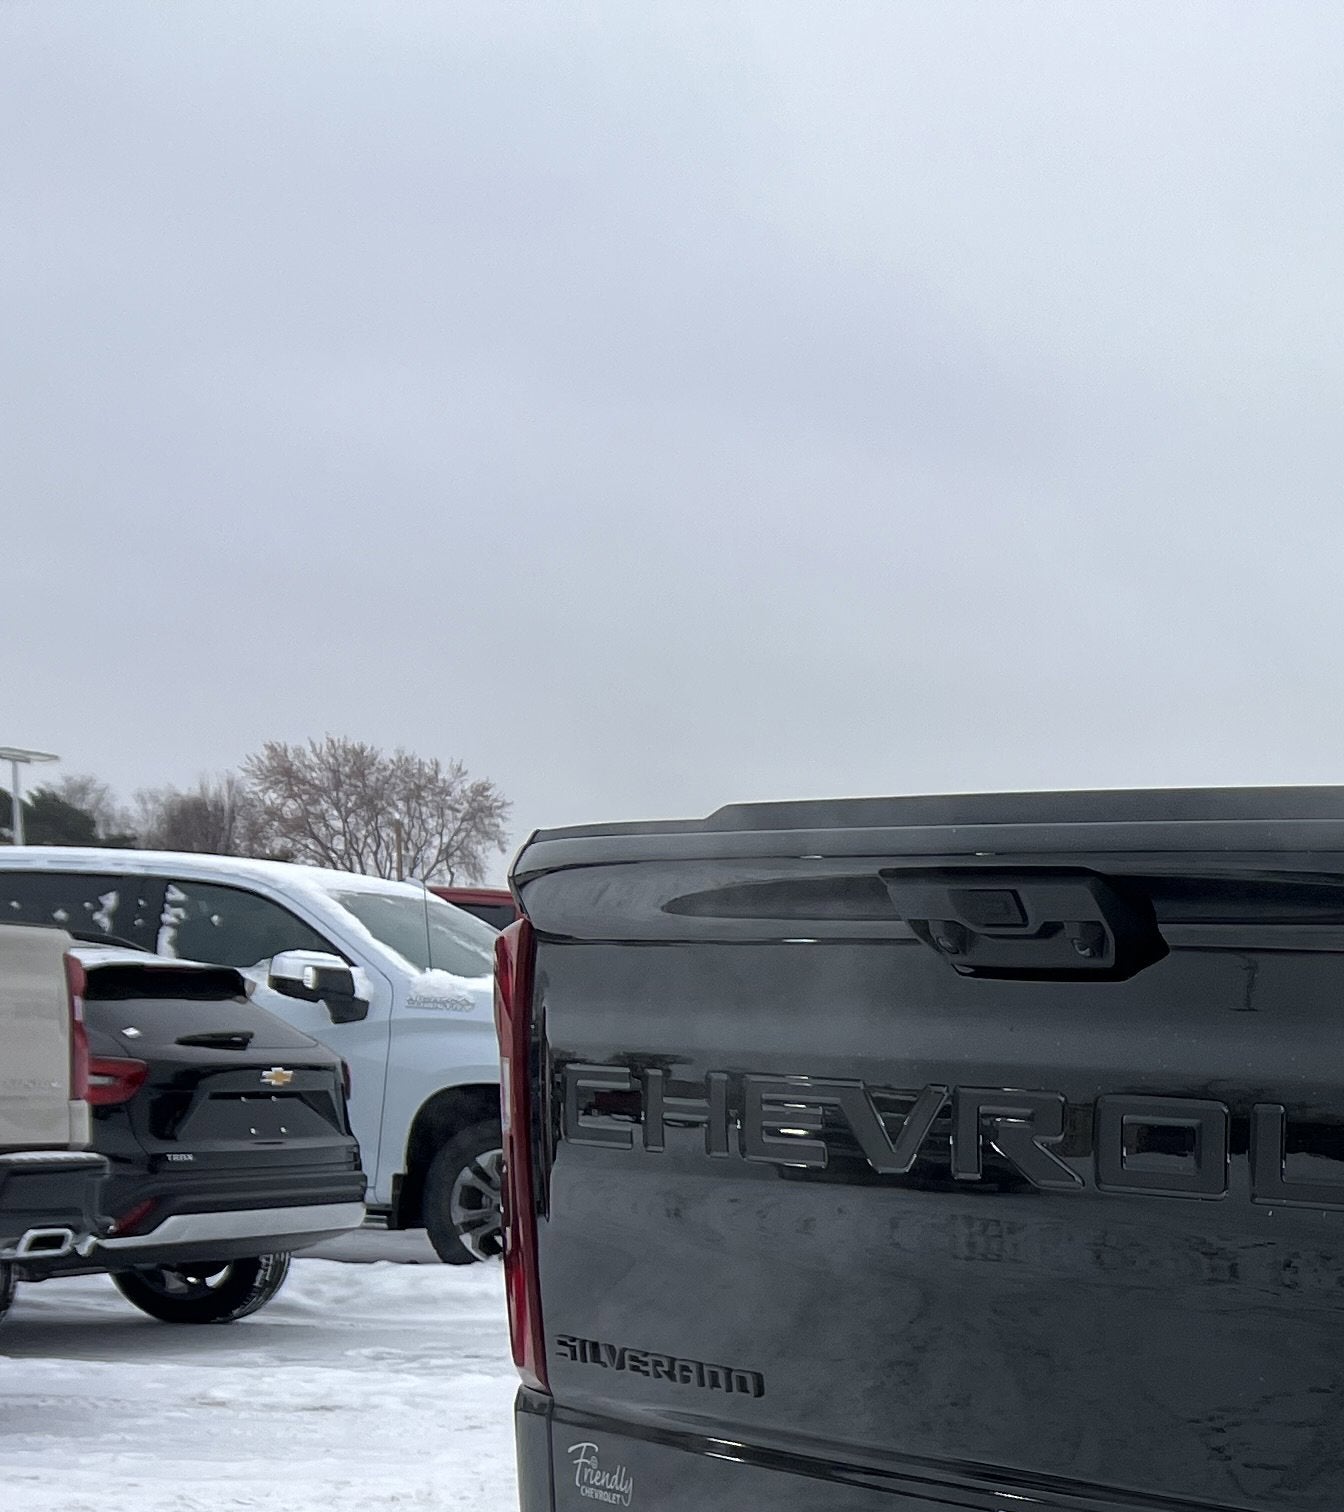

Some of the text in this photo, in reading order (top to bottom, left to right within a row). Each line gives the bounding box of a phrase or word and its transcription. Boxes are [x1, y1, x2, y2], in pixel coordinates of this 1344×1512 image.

[555, 1334, 766, 1398] SILVERADO
[568, 1442, 633, 1506] Friendly
[580, 1485, 621, 1504] CHEVROLET
